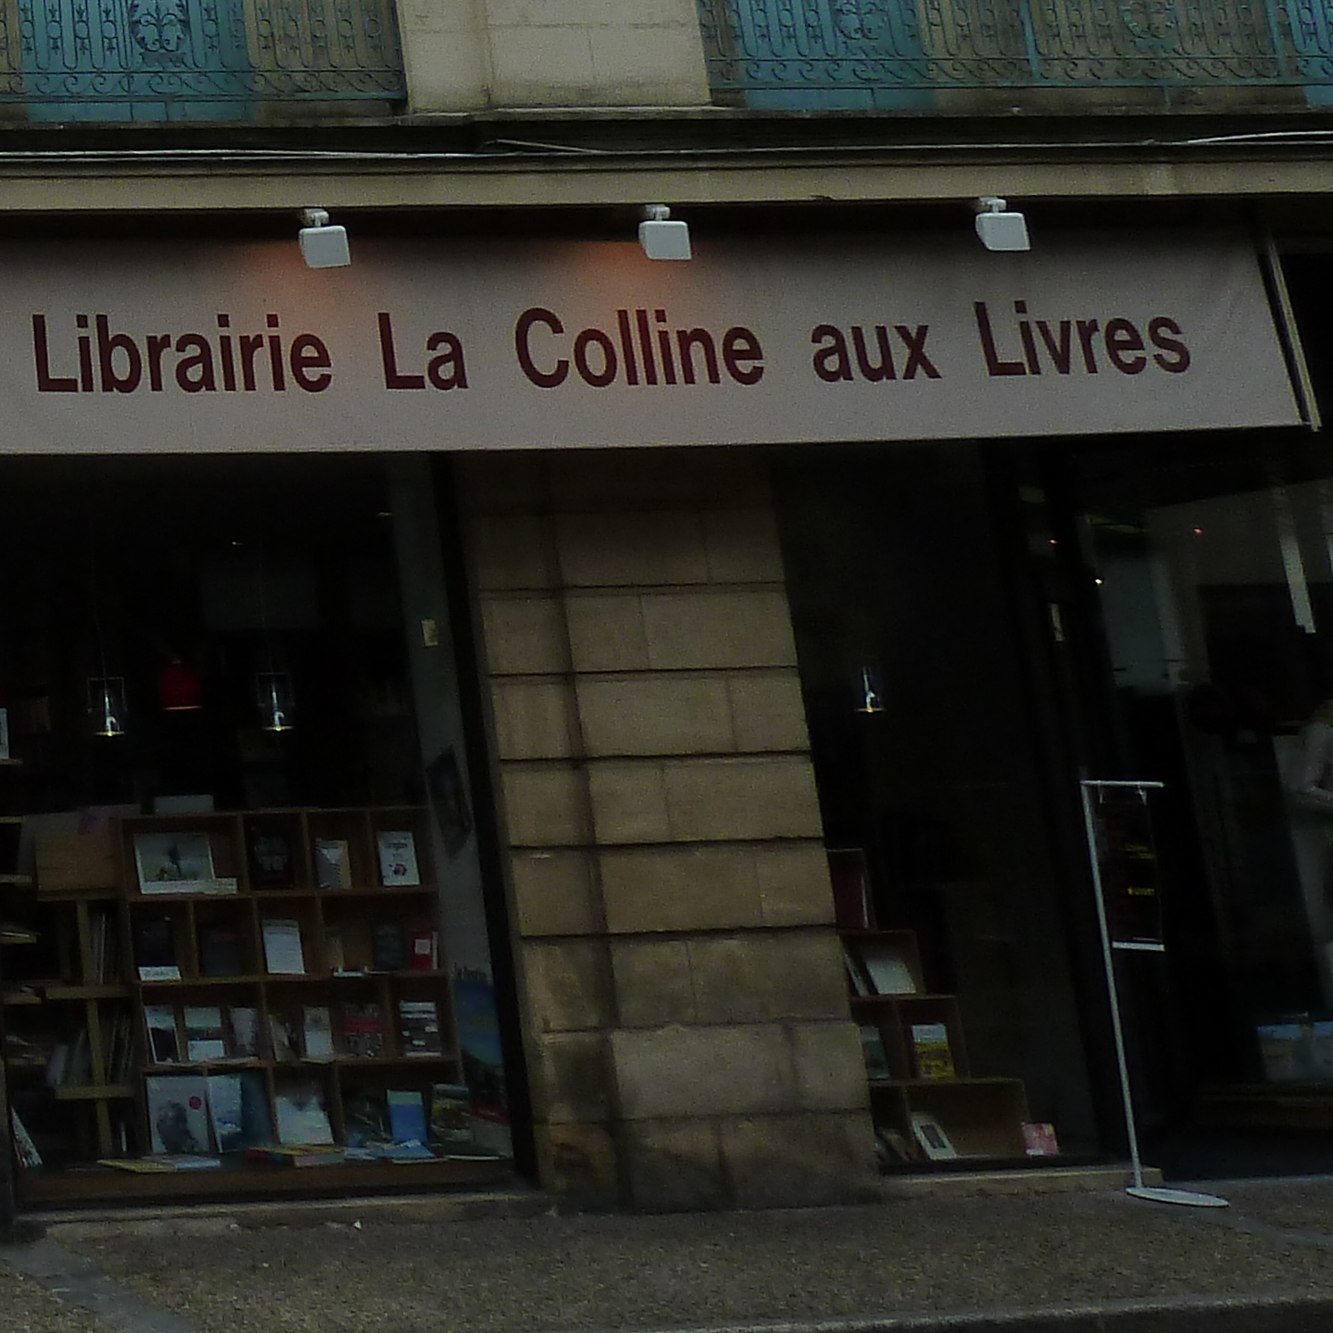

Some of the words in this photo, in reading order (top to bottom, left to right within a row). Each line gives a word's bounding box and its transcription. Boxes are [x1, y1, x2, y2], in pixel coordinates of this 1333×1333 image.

[32, 312, 332, 396] Librairie
[380, 311, 467, 391] La
[515, 307, 766, 390] Colline
[812, 319, 943, 385] aux
[975, 300, 1191, 379] Livres
